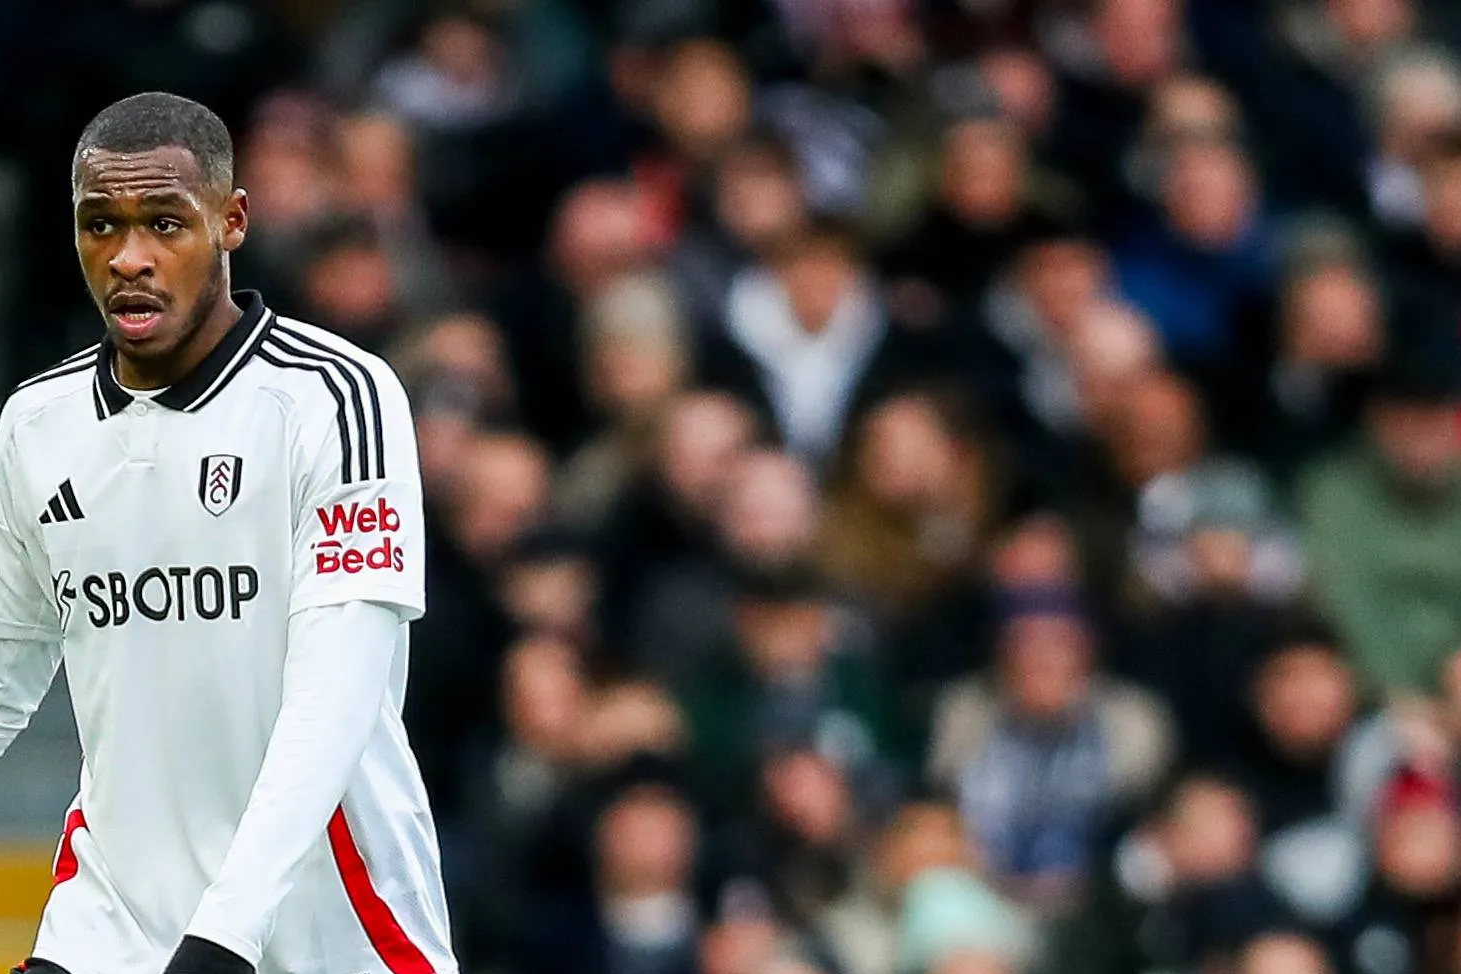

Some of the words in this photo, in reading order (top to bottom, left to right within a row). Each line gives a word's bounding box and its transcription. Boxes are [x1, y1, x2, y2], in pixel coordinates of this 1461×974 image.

[316, 497, 400, 536] Web
[311, 536, 404, 575] Beds
[82, 565, 259, 628] SBOTOP
